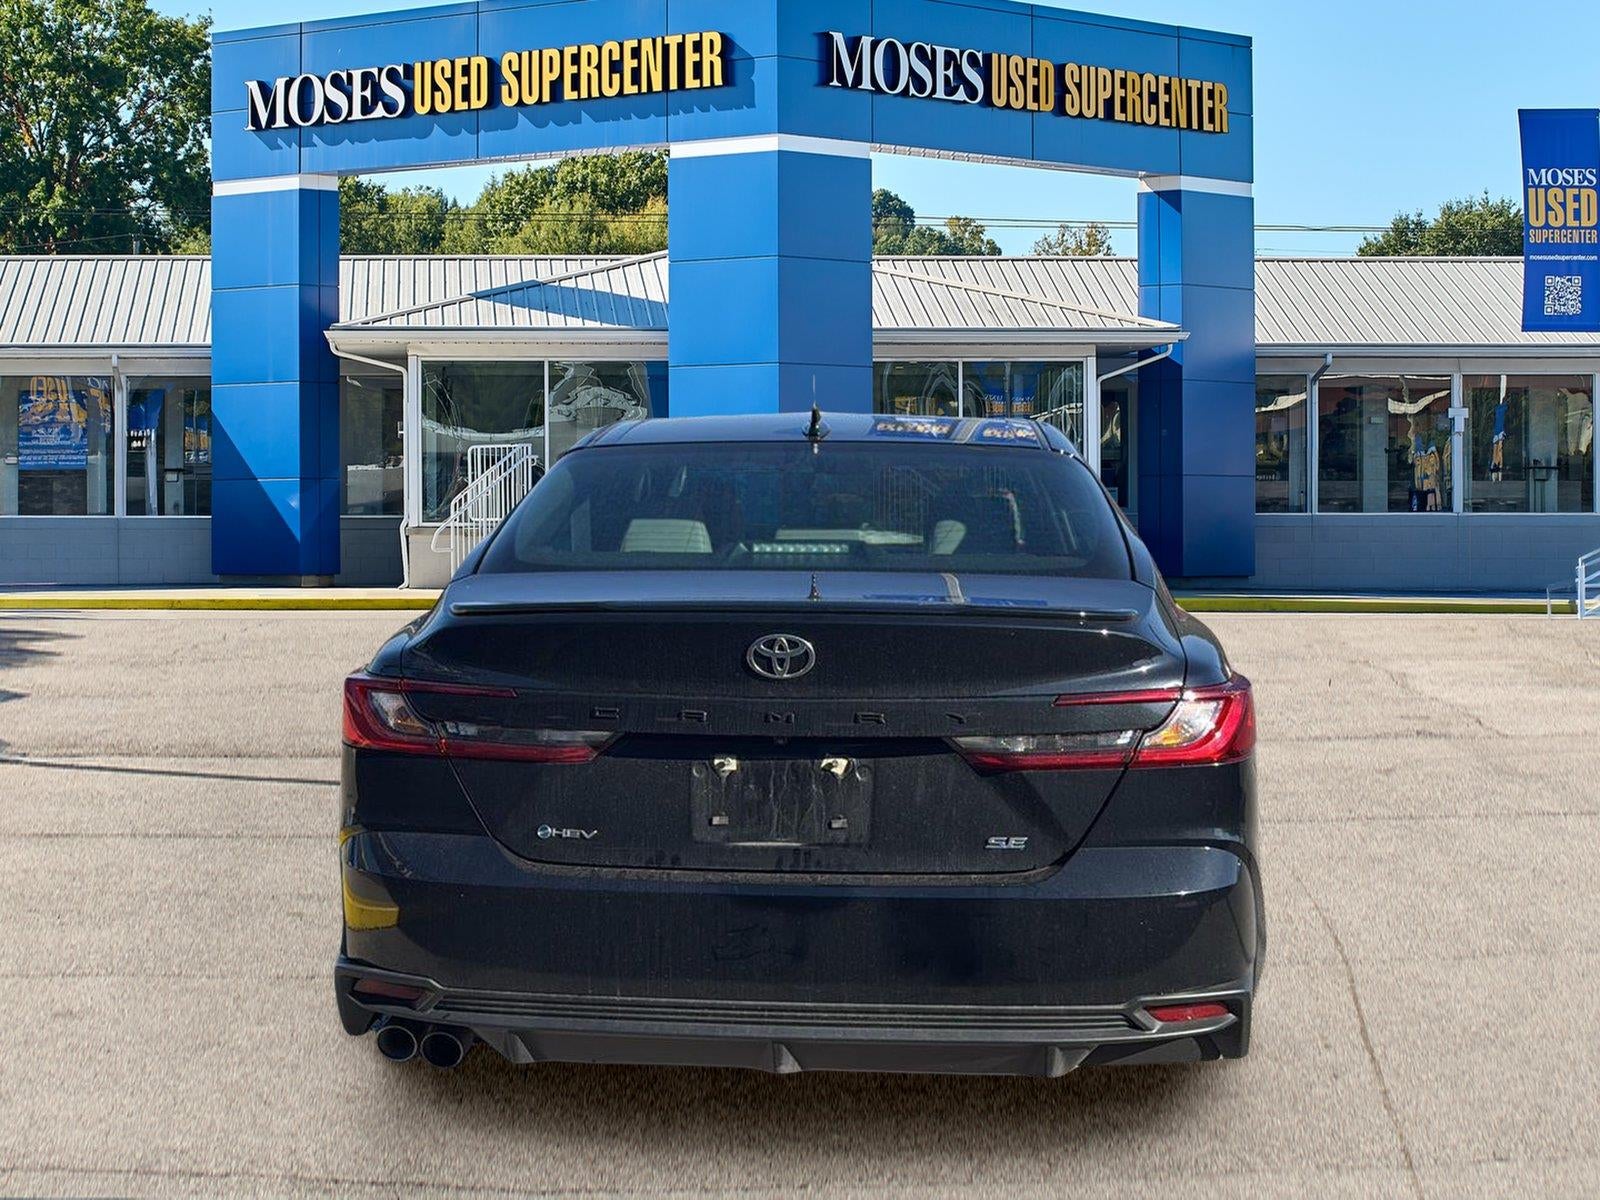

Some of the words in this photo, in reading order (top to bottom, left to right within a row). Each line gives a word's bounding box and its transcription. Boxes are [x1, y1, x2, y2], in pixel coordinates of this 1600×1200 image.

[244, 63, 407, 132] MOSES
[411, 55, 490, 116] USED
[500, 30, 724, 108] SUPERCENTER
[827, 31, 985, 105] MOSES
[990, 52, 1056, 113] USED
[1064, 62, 1229, 134] SUPERCENTER
[1527, 167, 1597, 187] MOSES
[1528, 187, 1598, 228] USED
[1529, 228, 1598, 244] SUPERCENTER
[984, 836, 1029, 849] SE
